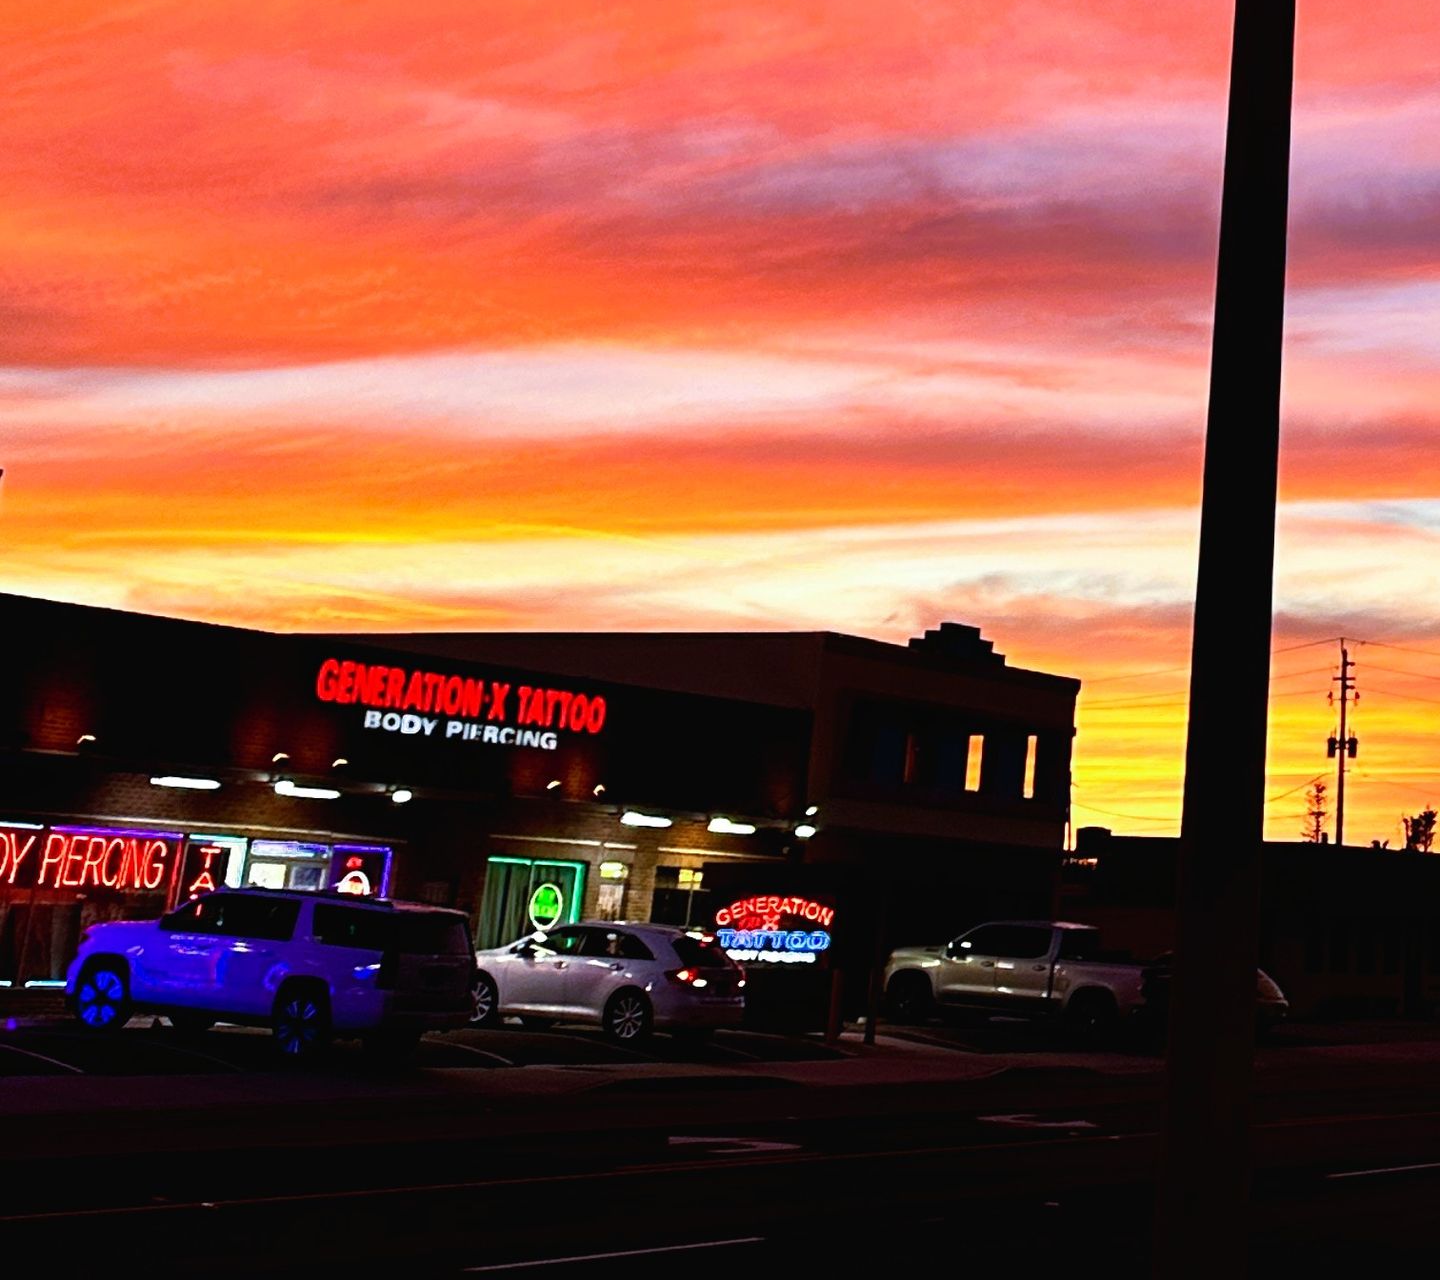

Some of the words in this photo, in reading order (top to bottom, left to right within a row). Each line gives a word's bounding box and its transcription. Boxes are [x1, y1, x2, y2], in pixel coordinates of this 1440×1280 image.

[364, 710, 439, 736] BODY
[445, 720, 558, 750] PIERCING
[517, 686, 607, 734] TATTOO
[37, 834, 168, 890] PIERCING
[715, 896, 834, 926] GENERATION
[717, 928, 831, 951] TATTOO
